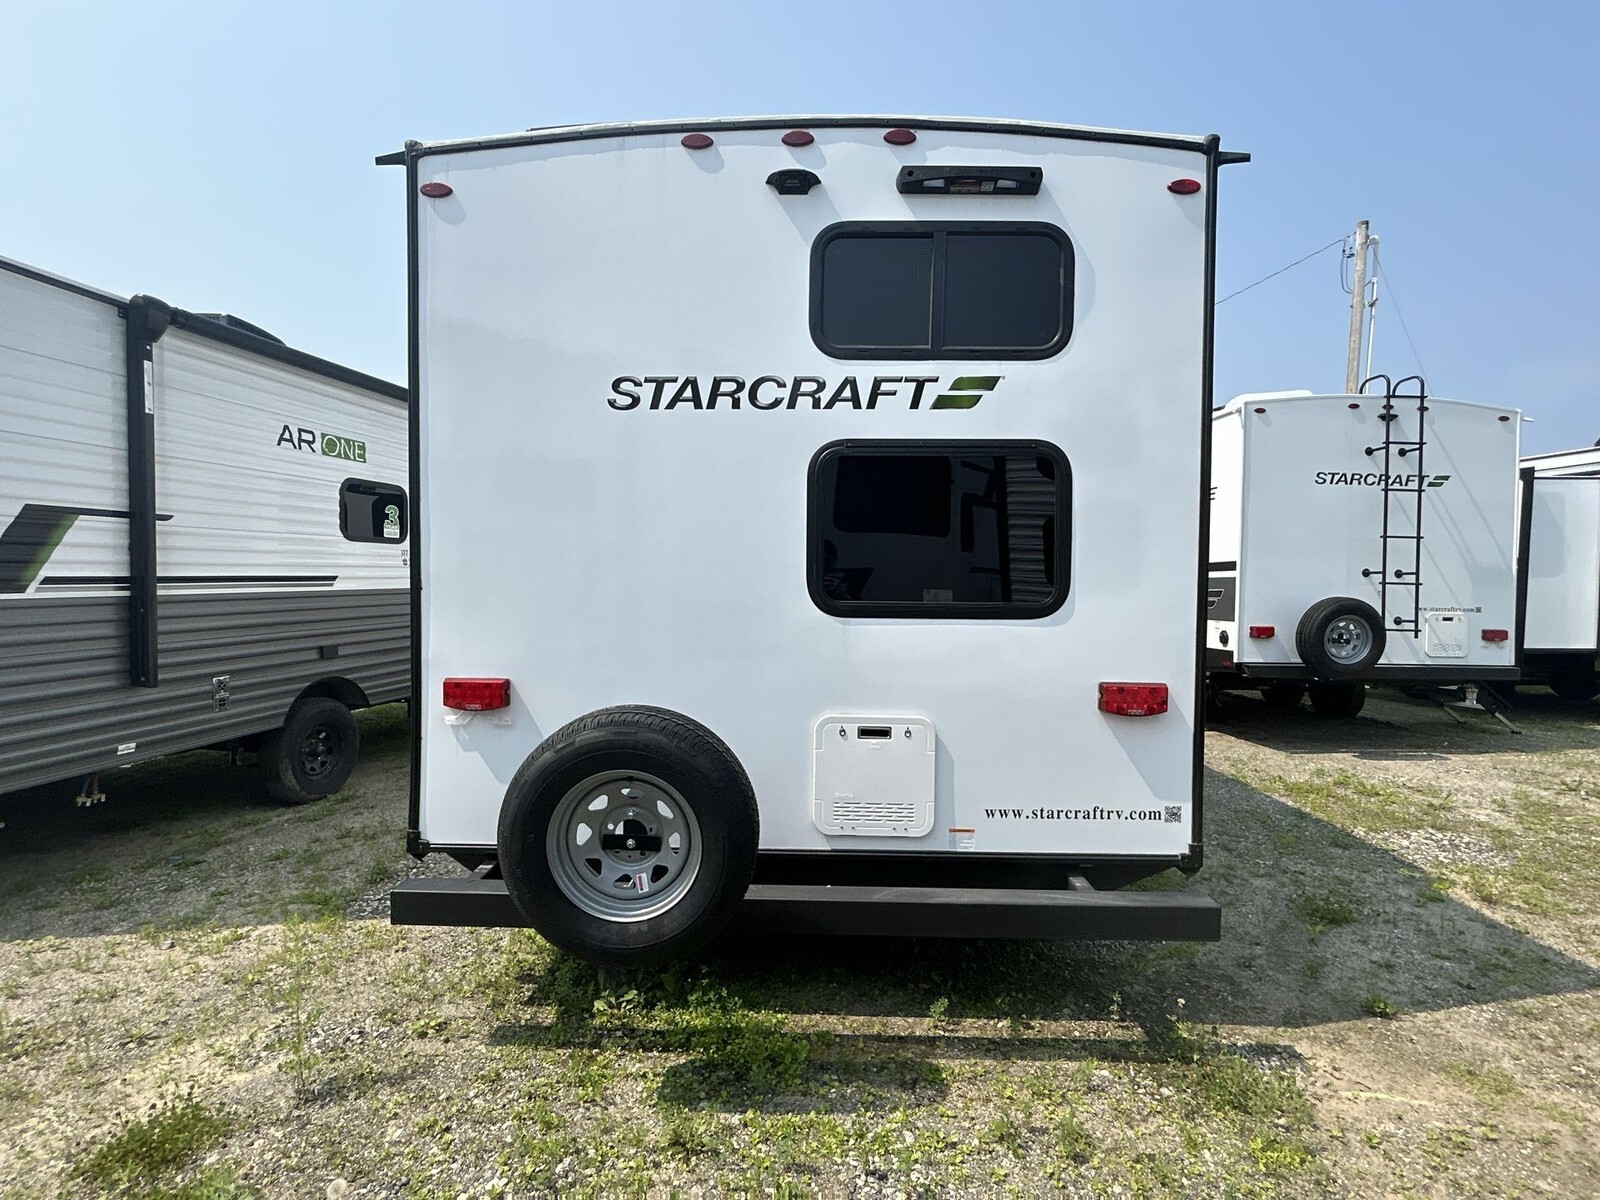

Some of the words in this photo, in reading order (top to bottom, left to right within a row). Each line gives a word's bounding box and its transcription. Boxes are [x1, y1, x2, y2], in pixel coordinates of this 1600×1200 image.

[606, 375, 940, 411] STARCRAFT
[276, 424, 316, 453] AR
[322, 435, 365, 462] ONE
[384, 505, 399, 526] 3
[984, 806, 1163, 821] www.starcraftrv.com
